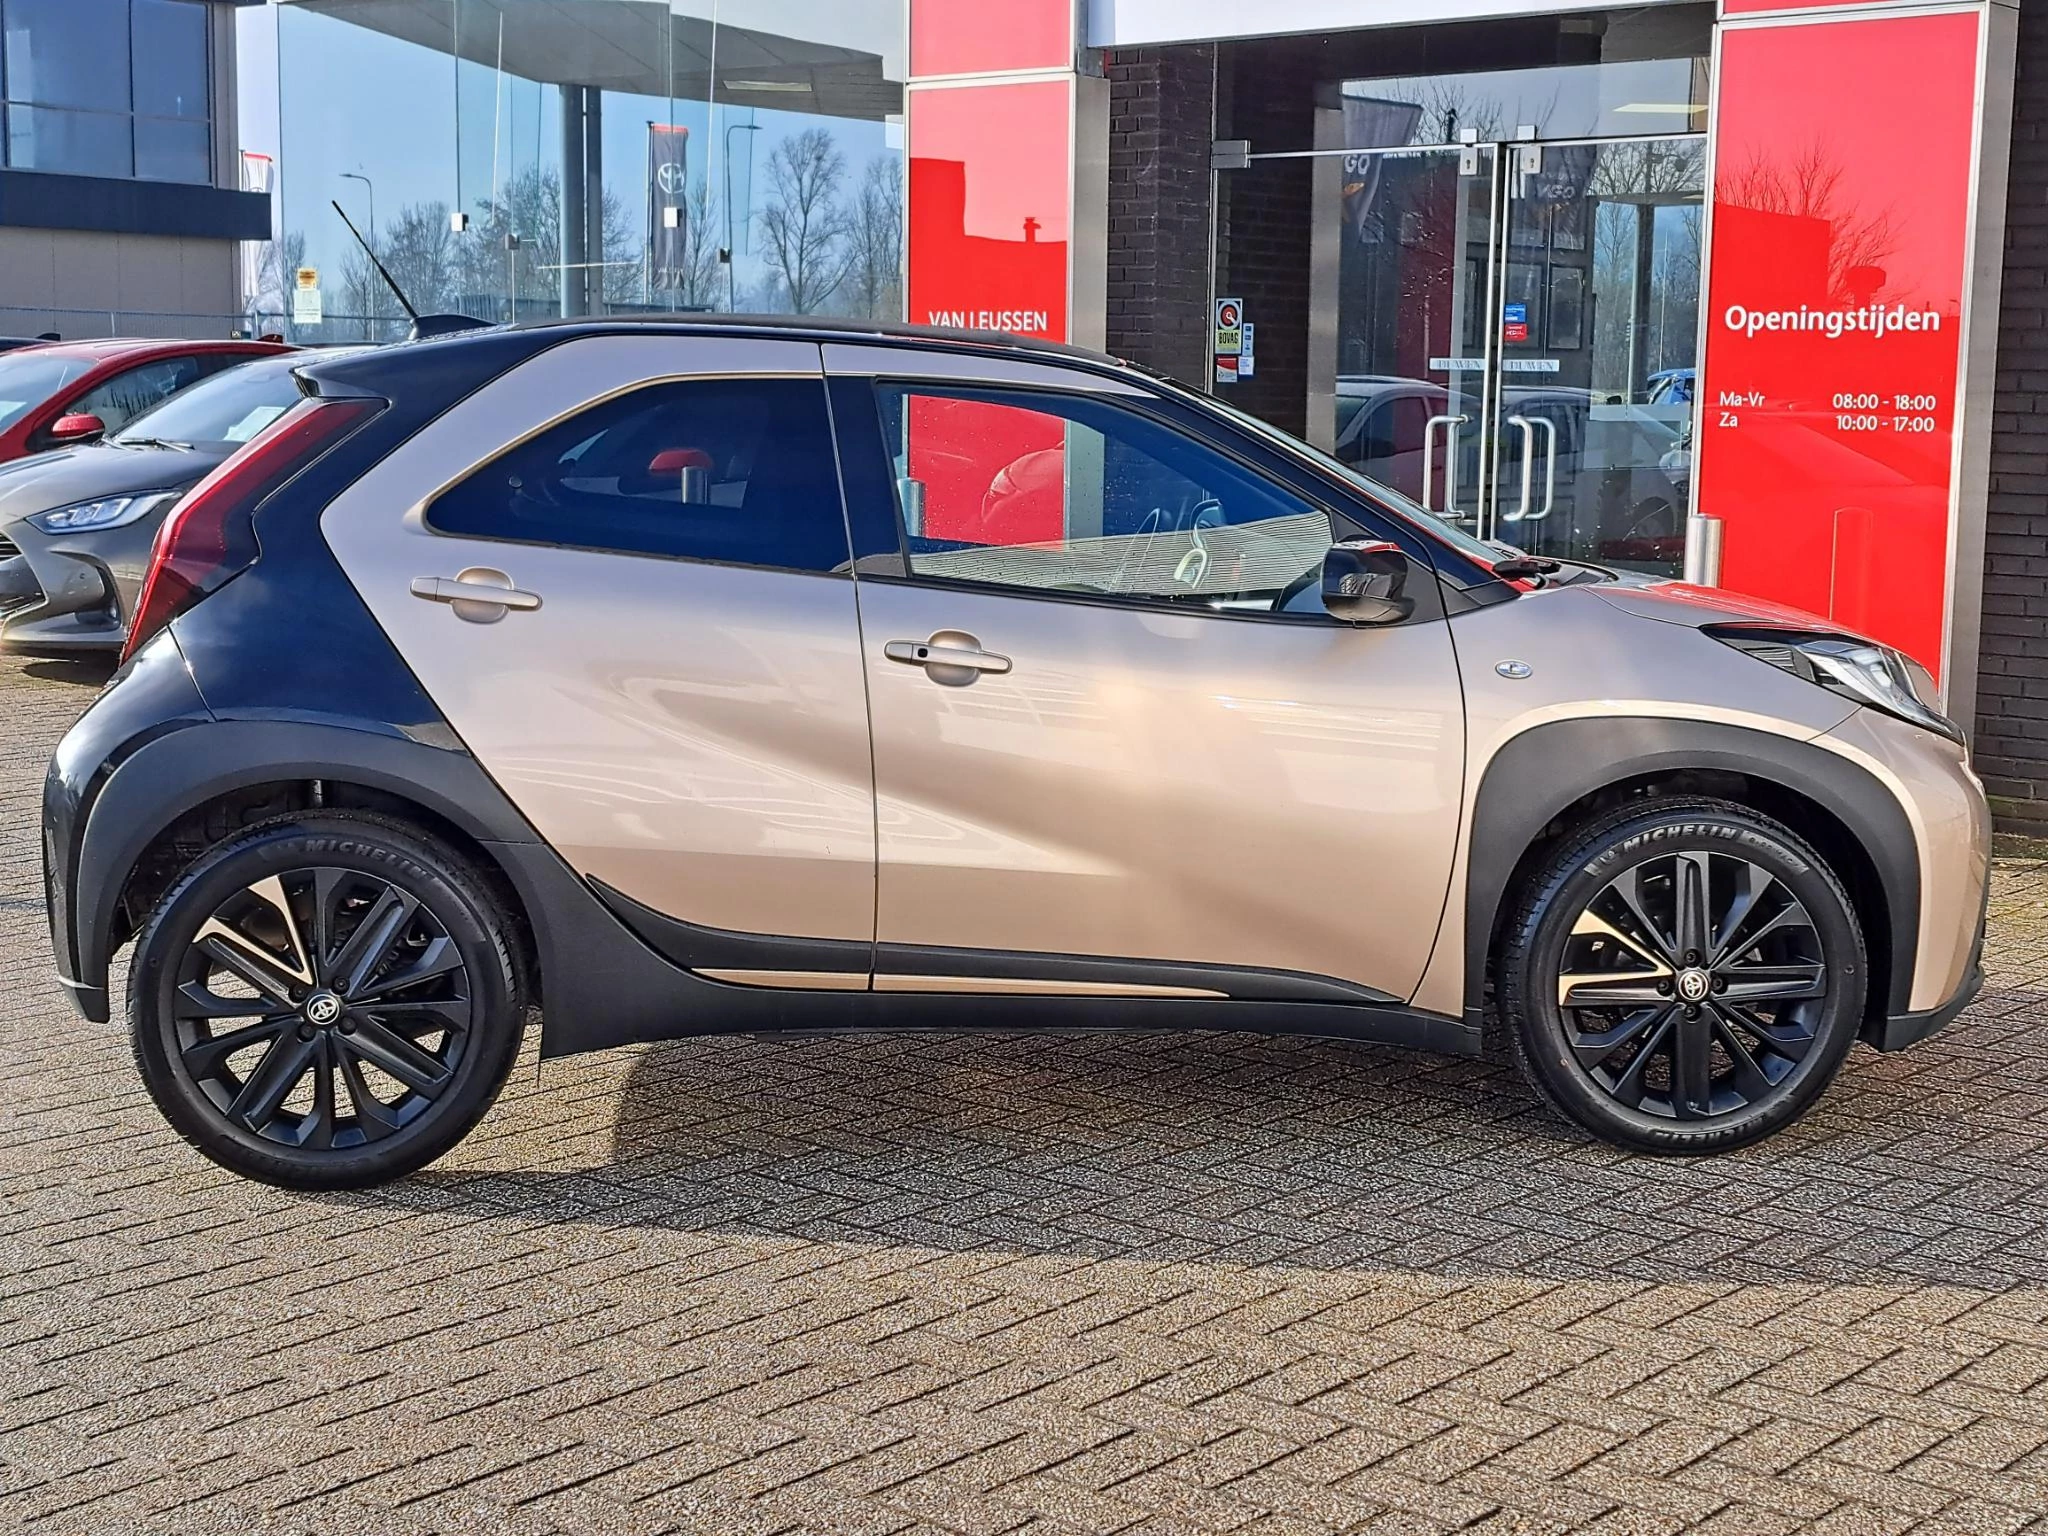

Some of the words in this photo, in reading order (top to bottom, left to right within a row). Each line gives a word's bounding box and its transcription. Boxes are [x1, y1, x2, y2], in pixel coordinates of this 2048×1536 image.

[929, 311, 965, 328] VAN
[969, 311, 1047, 331] LEUSSEN
[1725, 304, 1940, 338] Openingstijden
[1218, 332, 1239, 344] BOVAG
[1719, 391, 1765, 407] Ma-Vr
[1833, 394, 1879, 409] 08:00
[1895, 394, 1936, 411] 18:00
[1718, 412, 1738, 427] Za
[1836, 414, 1878, 431] 10:00
[1894, 416, 1935, 432] 17:00
[1624, 824, 1737, 852] MICHELIN
[304, 839, 429, 879] MICHELIN
